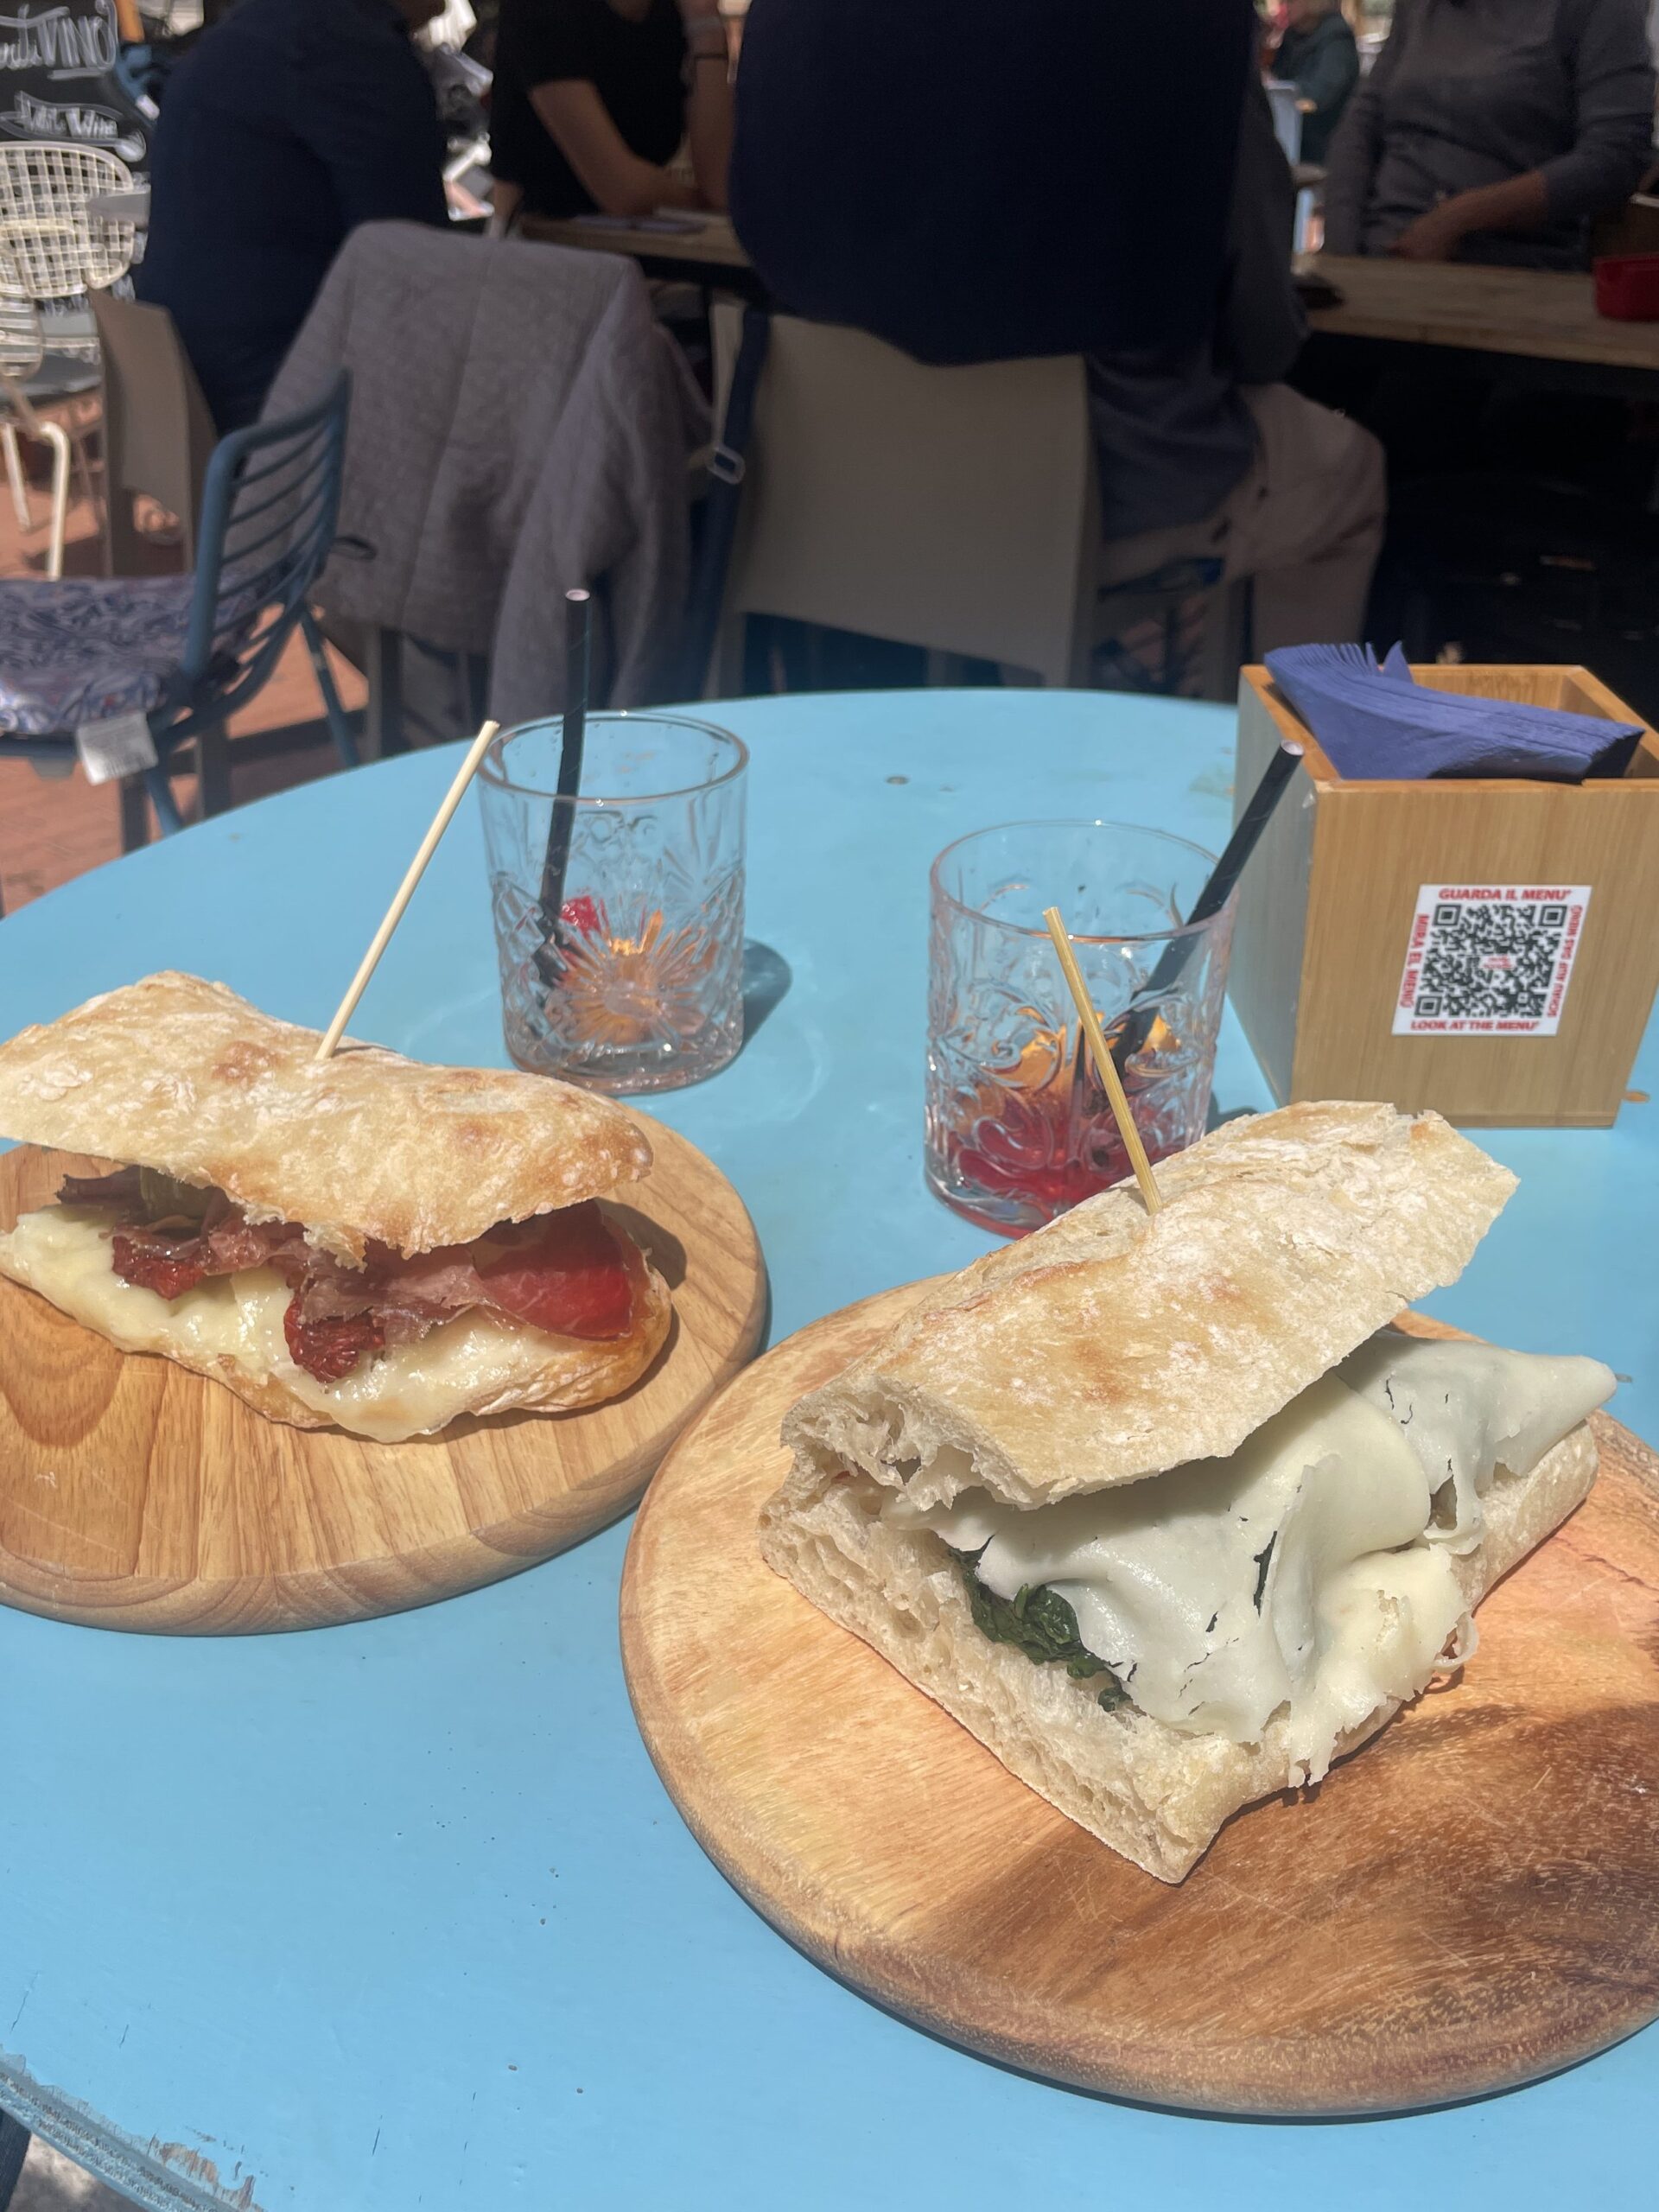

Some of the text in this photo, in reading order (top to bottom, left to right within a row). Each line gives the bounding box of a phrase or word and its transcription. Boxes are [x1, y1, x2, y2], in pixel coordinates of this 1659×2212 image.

[1440, 888, 1501, 899] GUARDA
[1506, 889, 1517, 899] IL
[1411, 914, 1429, 948] MIRA
[1560, 939, 1575, 960] DAS
[1408, 952, 1422, 967] EL
[1410, 1020, 1447, 1031] LOOK
[1451, 1020, 1467, 1031] AT
[1468, 1020, 1493, 1031] THE
